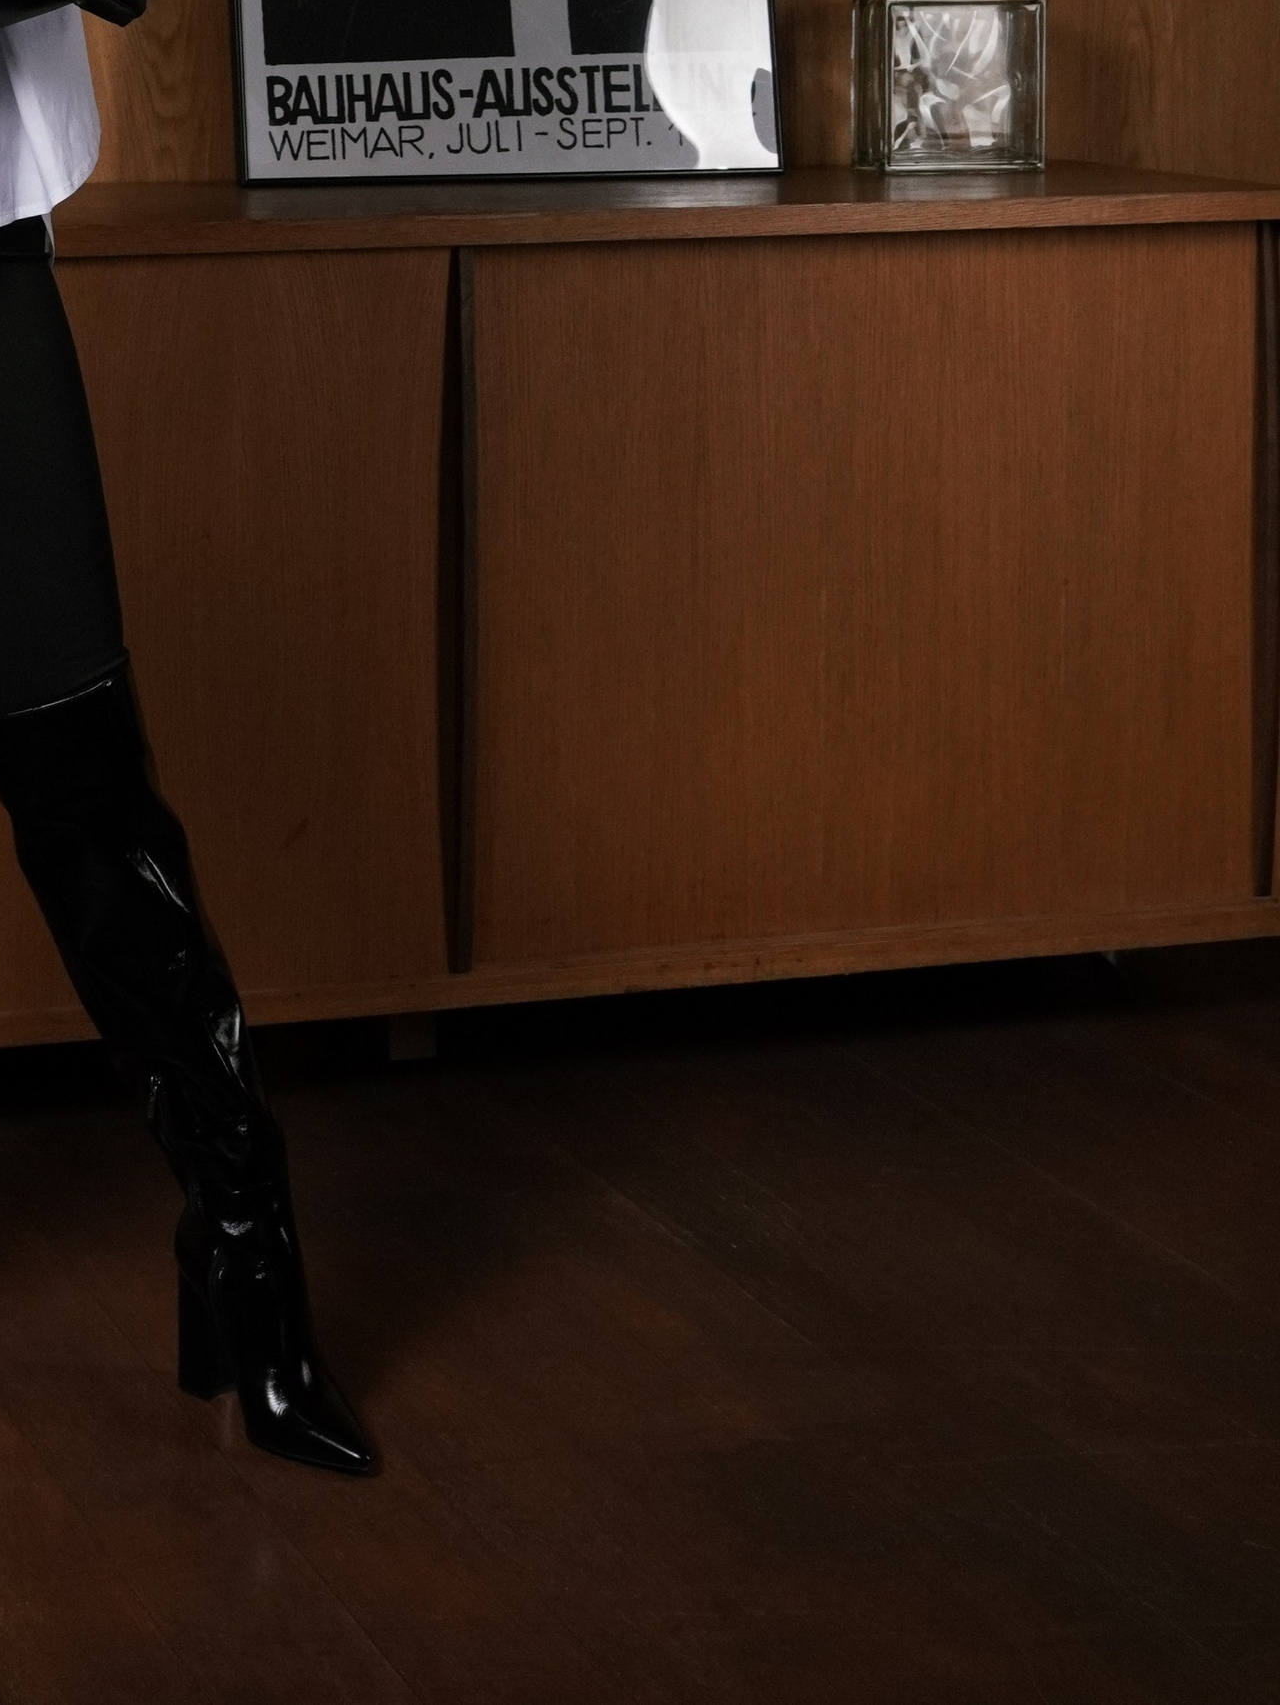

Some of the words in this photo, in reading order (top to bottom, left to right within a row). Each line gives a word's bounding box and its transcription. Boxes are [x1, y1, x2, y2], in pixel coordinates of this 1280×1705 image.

[268, 123, 435, 162] WEIMAR,
[446, 118, 524, 155] JULI
[555, 117, 653, 151] SEPT.
